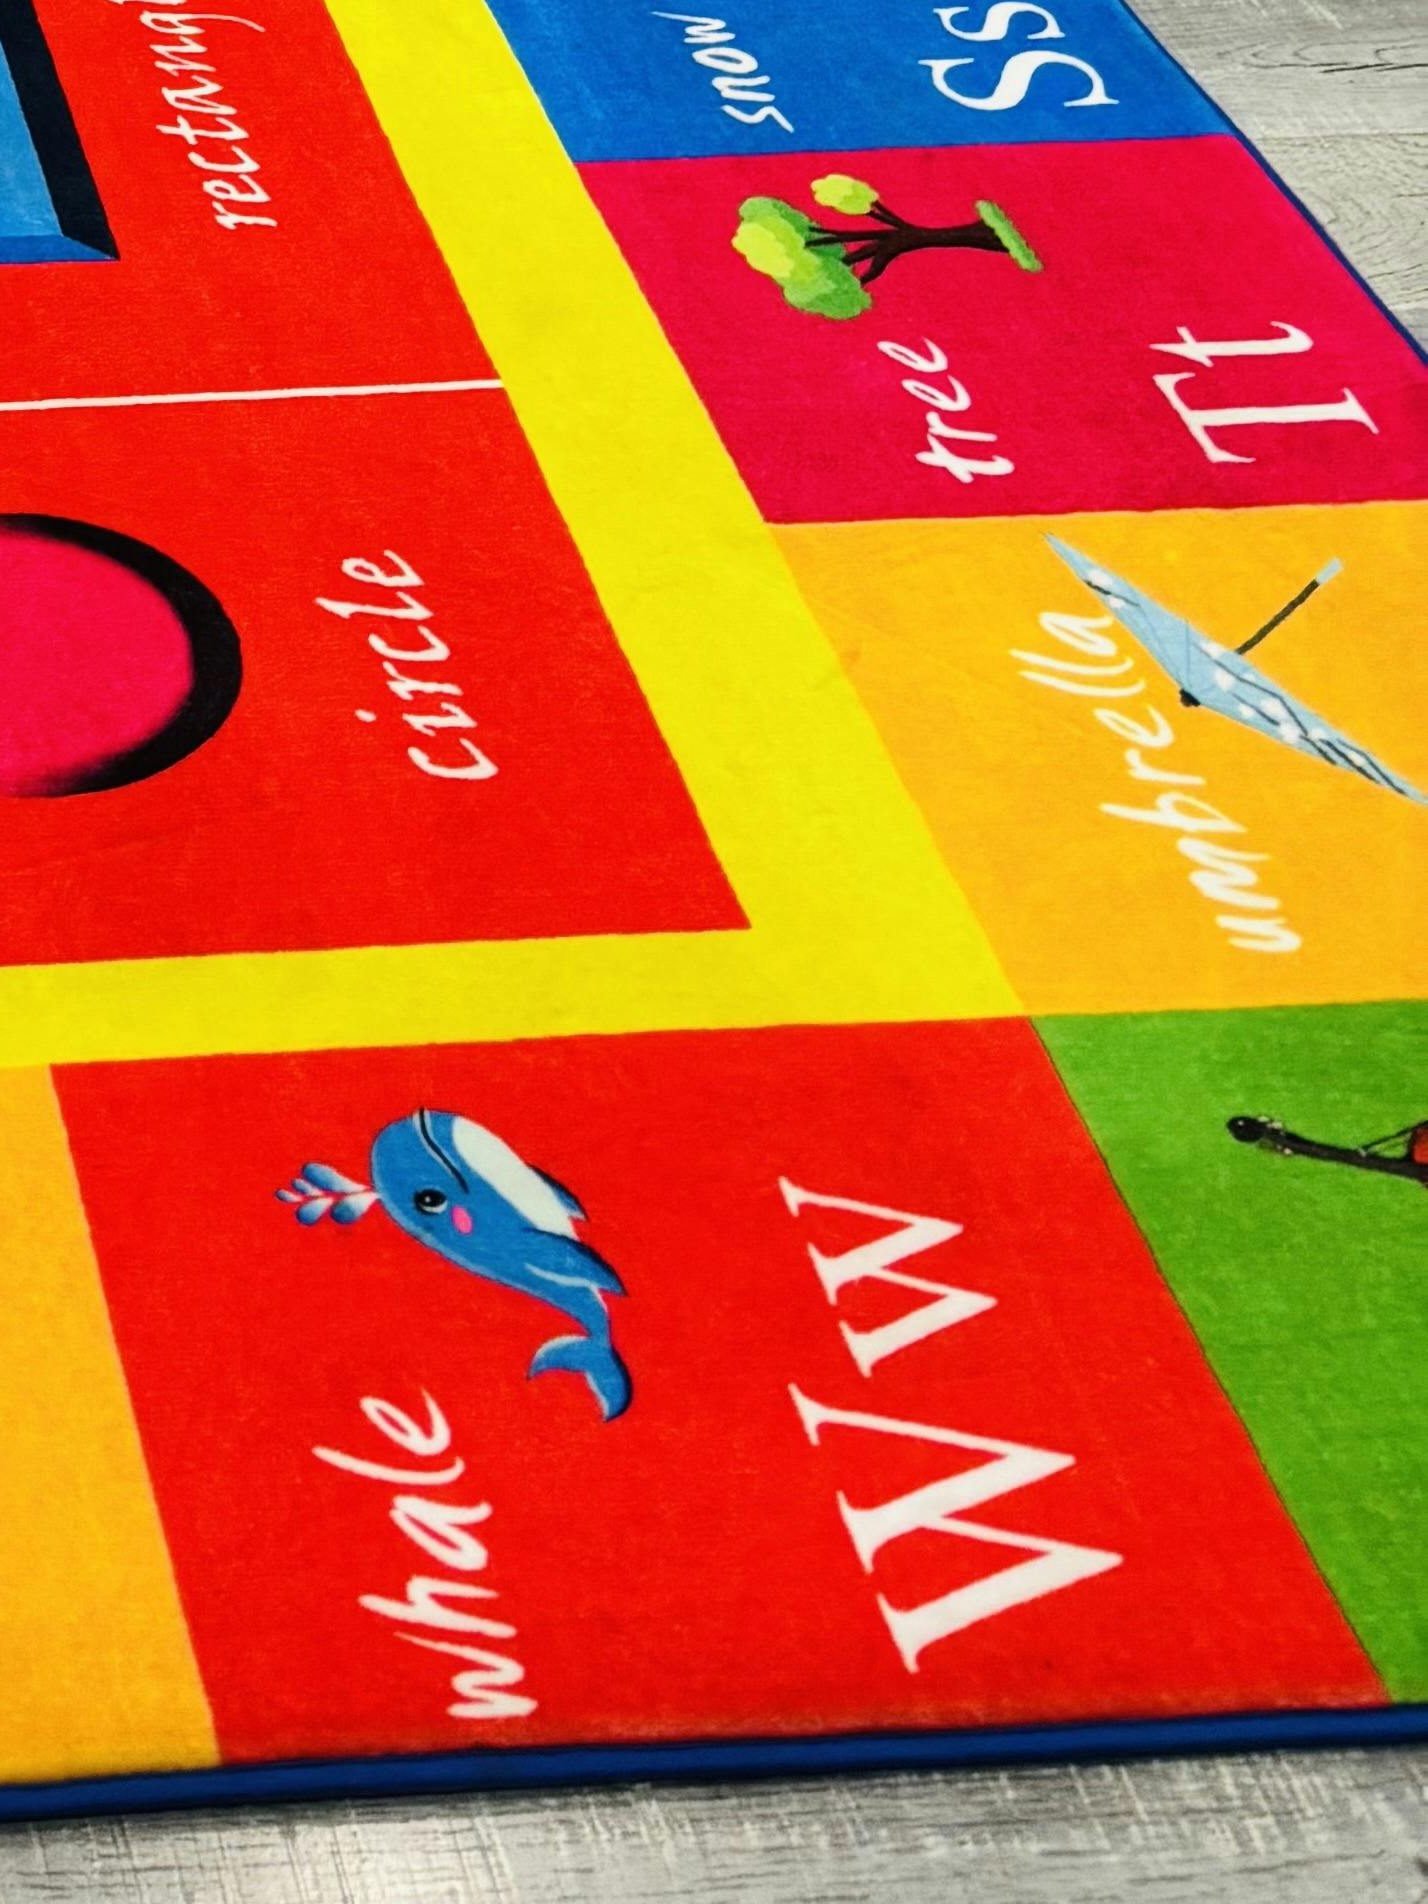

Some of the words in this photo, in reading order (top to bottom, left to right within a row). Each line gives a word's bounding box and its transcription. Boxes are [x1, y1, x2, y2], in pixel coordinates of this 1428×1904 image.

[653, 11, 794, 133] snow
[918, 1, 1119, 111] Ss
[877, 339, 1015, 484] tree
[1149, 321, 1379, 463] Tt
[315, 549, 499, 781] circle
[1008, 609, 1303, 955] umbrella
[779, 1177, 1123, 1673] Ww
[312, 1393, 538, 1719] whale
